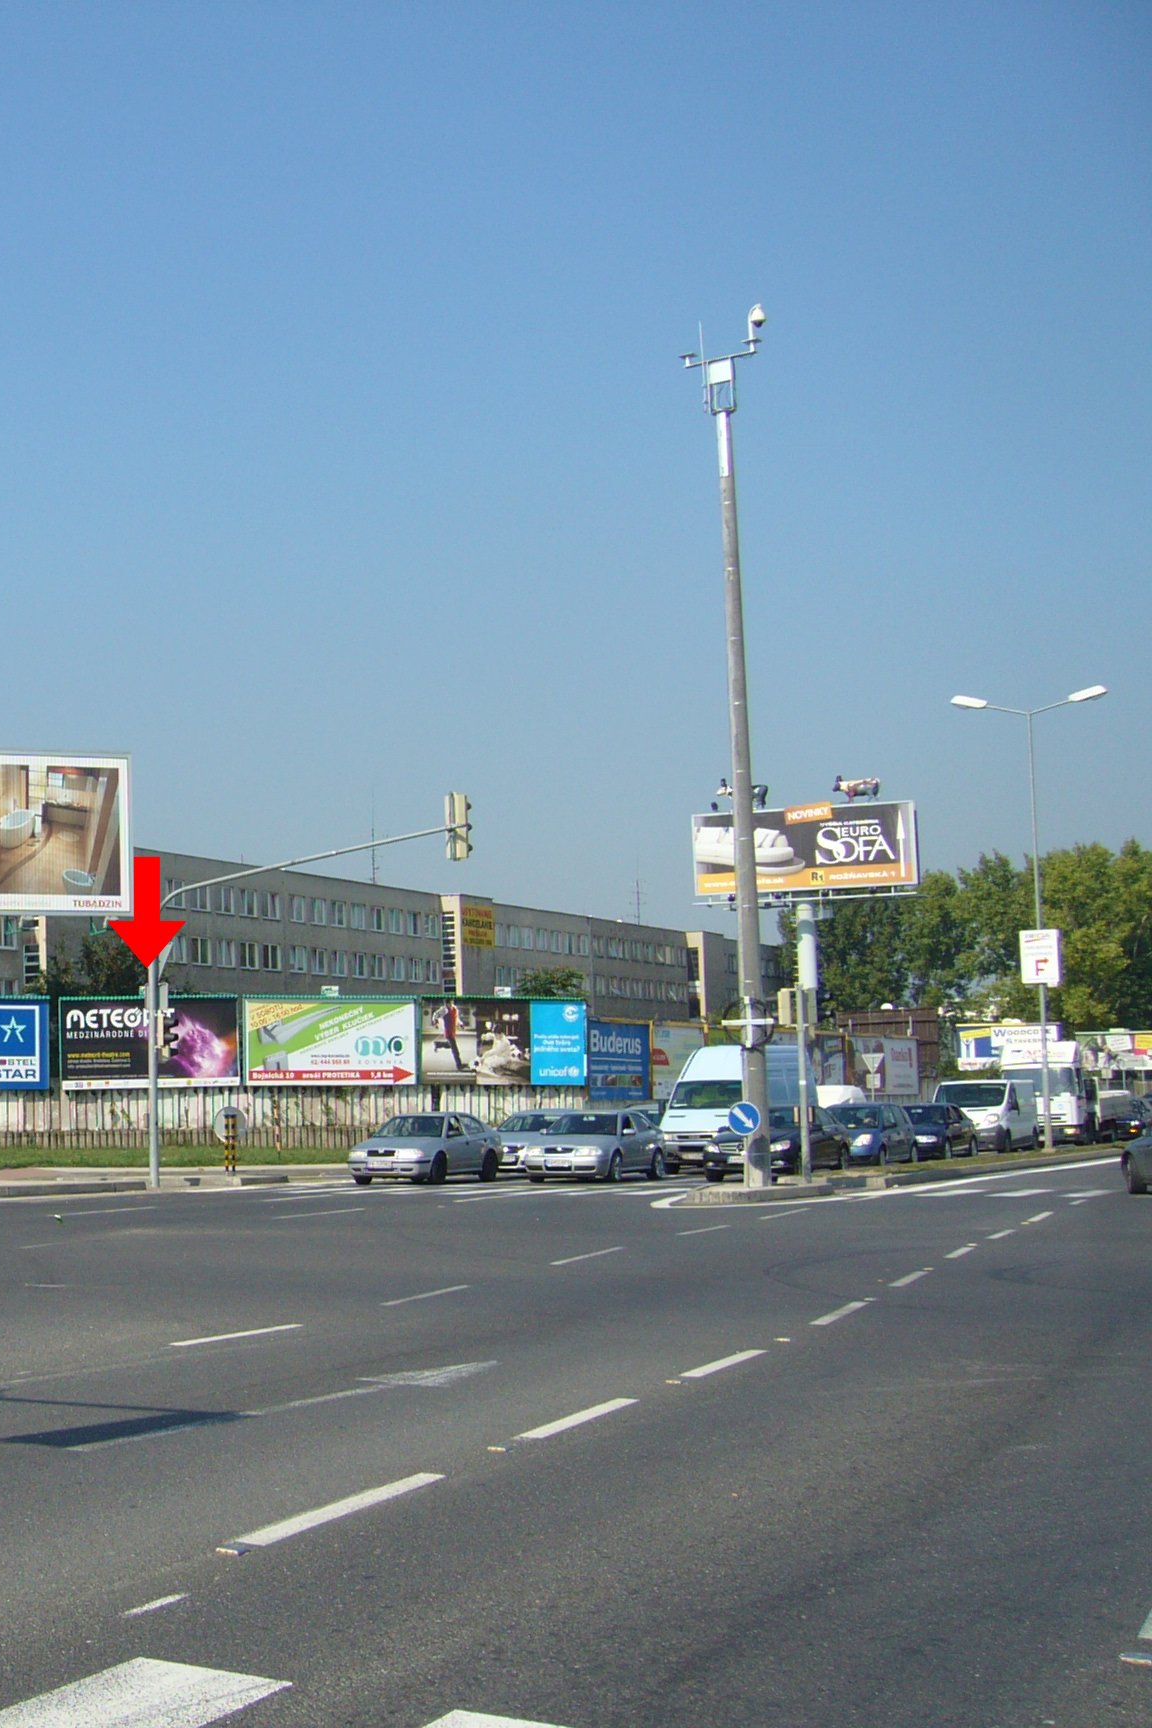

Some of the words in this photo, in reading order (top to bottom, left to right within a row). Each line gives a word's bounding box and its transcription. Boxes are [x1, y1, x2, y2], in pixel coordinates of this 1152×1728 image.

[787, 806, 829, 822] NOVINKY
[841, 825, 881, 836] EURO
[816, 827, 895, 865] SOFA
[811, 871, 824, 881] R1
[66, 1030, 134, 1039] MEDZINÁRODNÉ
[590, 1030, 641, 1054] Buderus
[539, 1066, 567, 1077] unicef
